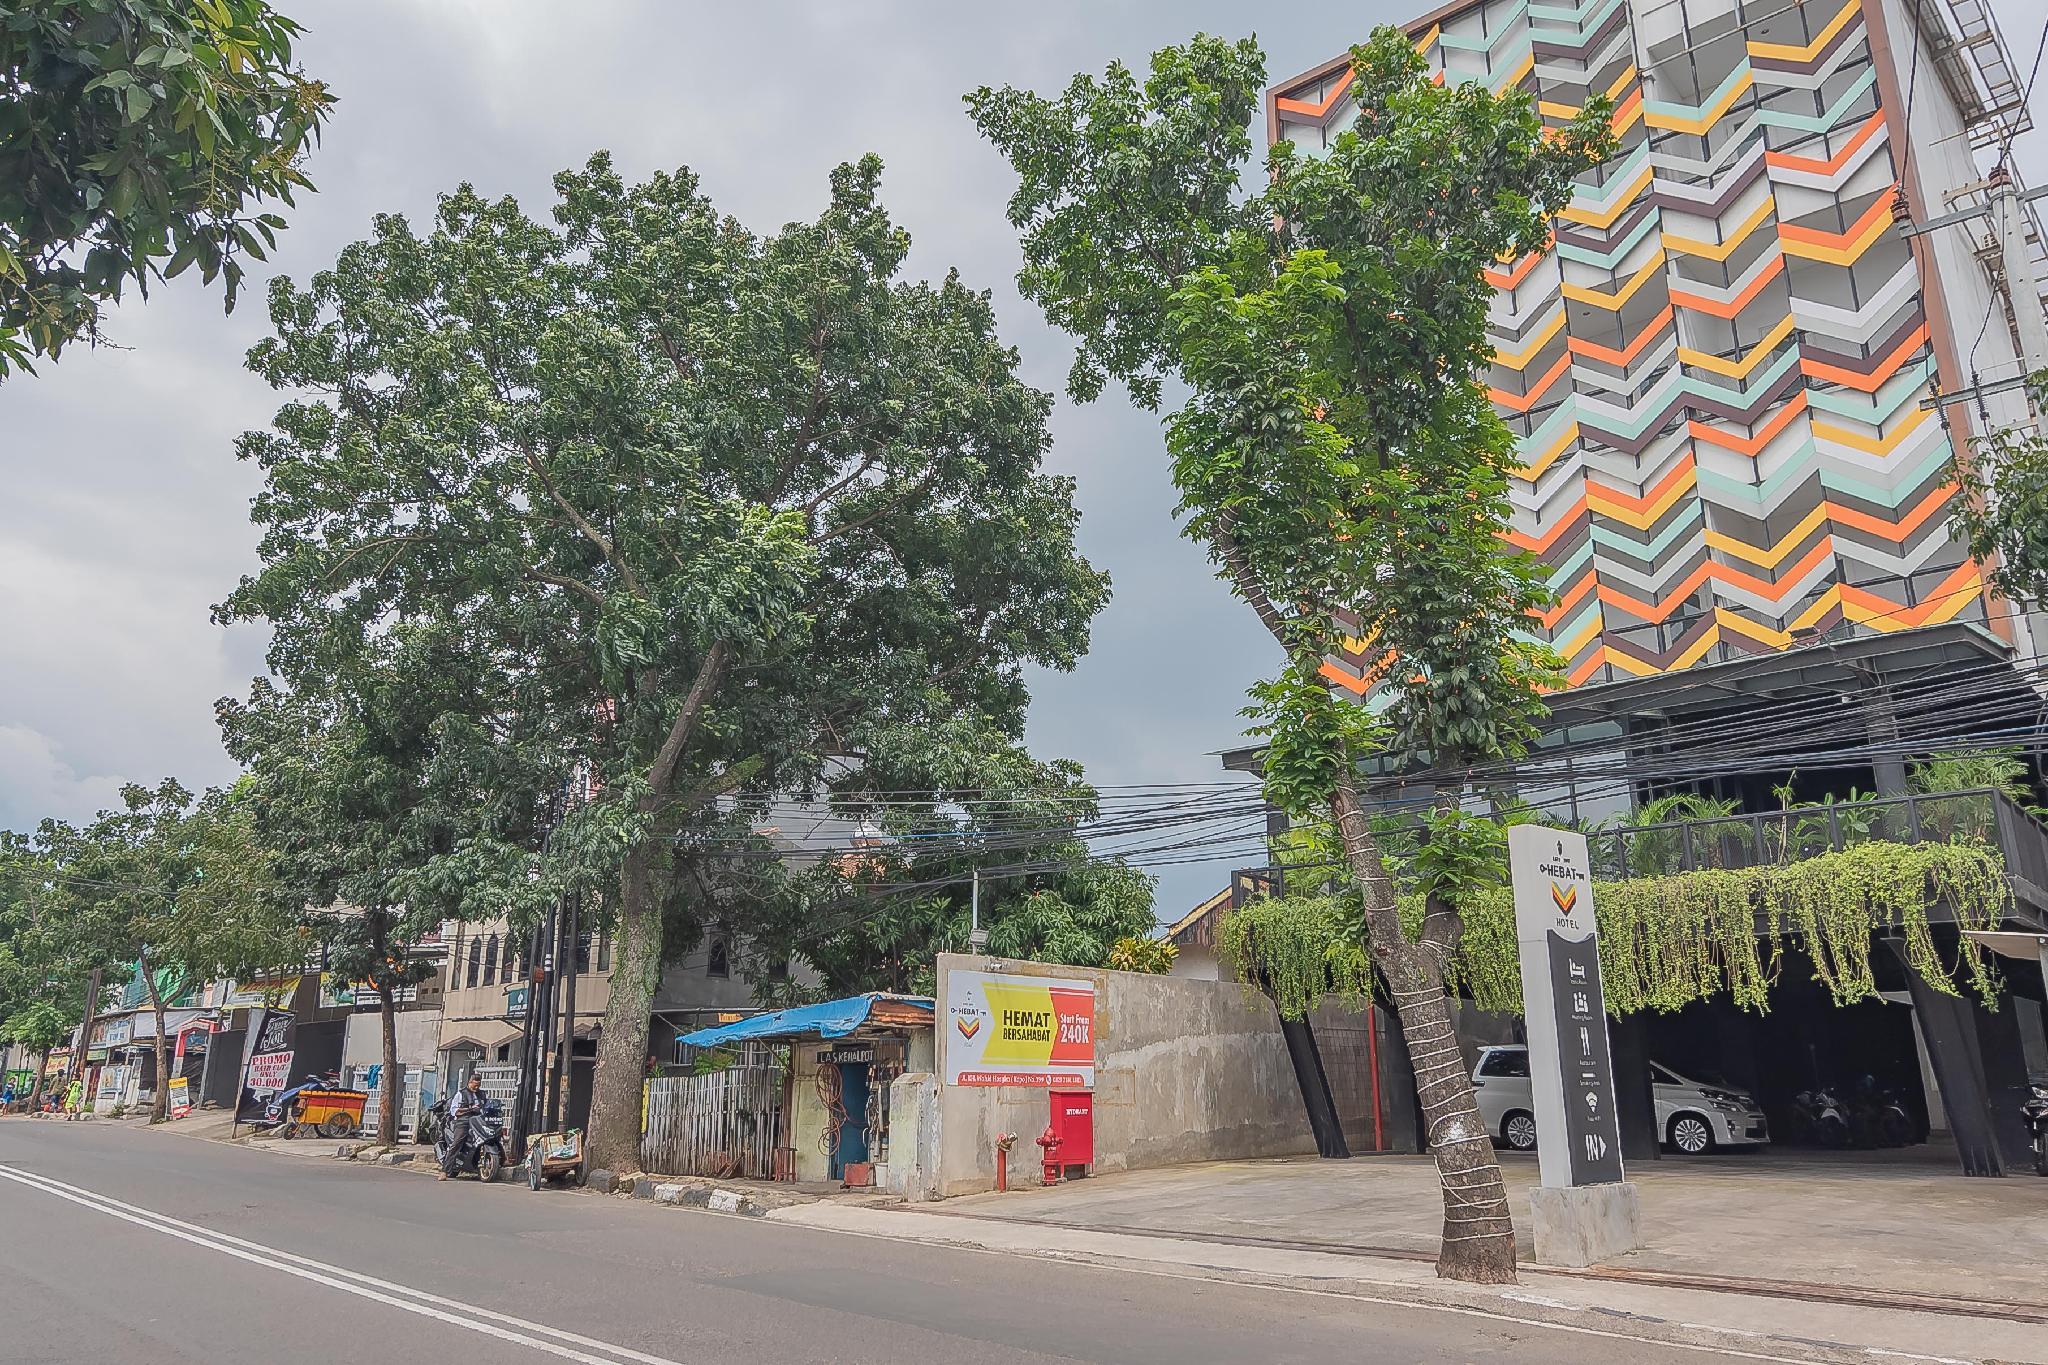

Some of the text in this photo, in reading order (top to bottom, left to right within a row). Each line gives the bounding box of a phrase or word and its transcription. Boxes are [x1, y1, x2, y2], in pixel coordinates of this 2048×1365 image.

[1547, 864, 1576, 880] HEBAT
[1556, 918, 1579, 930] HOTEL
[958, 1008, 979, 1016] HEBAT
[1003, 1010, 1051, 1028] HEMAT
[1060, 1013, 1090, 1025] Start From
[1003, 1028, 1051, 1042] BERSAHABAT
[1060, 1024, 1089, 1044] 240K
[252, 1052, 291, 1066] PROMO
[820, 1052, 837, 1063] LAS
[250, 1078, 284, 1088] 30.000
[1585, 1134, 1600, 1161] IN
